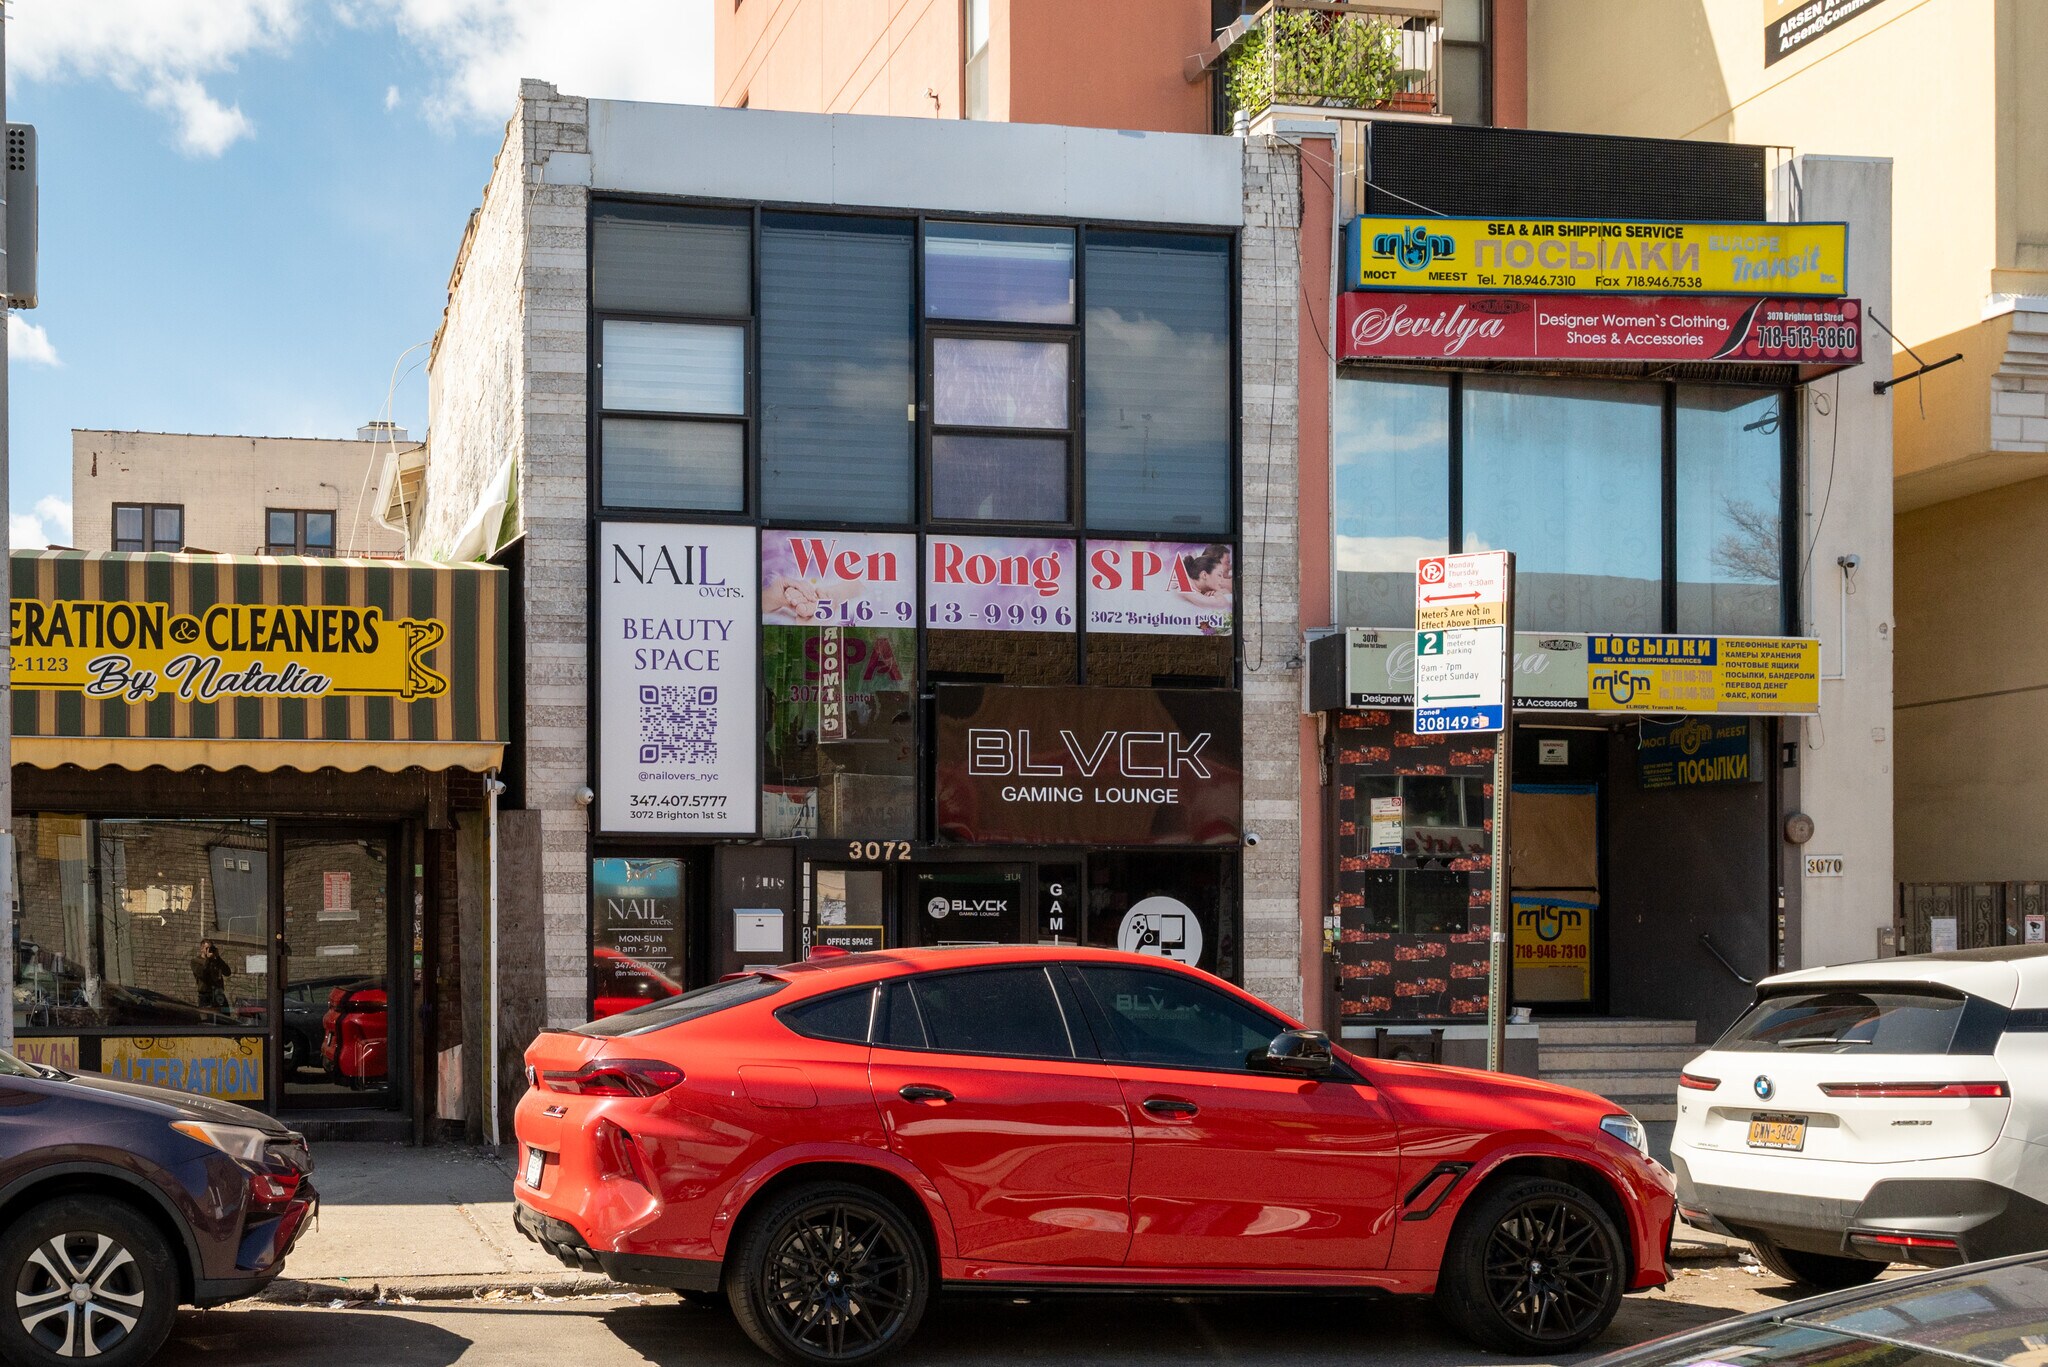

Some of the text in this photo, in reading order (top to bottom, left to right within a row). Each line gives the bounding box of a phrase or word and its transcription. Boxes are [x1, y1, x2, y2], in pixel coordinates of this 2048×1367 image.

[1779, 1, 1822, 38] ARSEN
[1488, 224, 1684, 238] SEA & AIR SHIPPING SERVICE
[1708, 236, 1780, 252] EUROPE
[1474, 239, 1699, 272] ПОСЫЛКИ
[1732, 245, 1820, 283] Transit
[1429, 272, 1468, 281] MEEST
[1477, 274, 1702, 288] Tel. 718.946.7310 Fax 718.946.7538
[1540, 314, 1598, 328] Designer
[1670, 316, 1730, 331] Clothing,
[1767, 312, 1844, 322] 3070 Brighton 1st Street
[1352, 304, 1505, 356] Sevilya
[1567, 332, 1704, 346] Shoes & Accessories
[1757, 326, 1856, 350] 718-513-3860
[612, 544, 726, 585] NAIL
[788, 538, 1194, 596] Wen Rong SPA
[1449, 569, 1479, 577] Thursday
[699, 586, 744, 598] overs.
[1092, 611, 1122, 623] 3072
[1126, 612, 1191, 627] Brighton
[1422, 610, 1448, 618] Meters
[1482, 606, 1490, 614] in
[10, 602, 164, 650] ERATION
[206, 607, 379, 654] CLEANERS
[622, 618, 734, 641] BEAUTY
[1422, 622, 1444, 630] Effect
[1363, 634, 1377, 642] 3070
[1424, 633, 1437, 654] 2
[1595, 638, 1710, 656] ПОСЫЛКИ
[634, 648, 720, 672] SPACE
[805, 636, 903, 680] SPA
[1421, 664, 1437, 672] 9am
[88, 656, 156, 700] By
[165, 655, 330, 698] Natalia
[1421, 672, 1479, 682] Except Sunday
[1769, 672, 1814, 680] БАНДЕРОЛИ
[1764, 682, 1788, 690] ДЕНЕГ
[1362, 694, 1401, 704] Designer
[1526, 699, 1578, 707] Accessories
[1418, 716, 1469, 730] 308149
[1717, 725, 1746, 738] MEEST
[969, 728, 1211, 778] BLVCK
[1678, 754, 1748, 784] ПОСЫЛКИ
[638, 772, 719, 782] @nailovers_nyc
[630, 795, 727, 807] 347.407.5777
[1002, 786, 1179, 804] GAMING LOUNGE
[630, 810, 727, 821] 3072 Brighton 1st St
[849, 841, 911, 860] 3072
[1808, 859, 1842, 873] 3070
[608, 899, 664, 920] NAIL
[952, 900, 1008, 912] BLVCK
[827, 938, 873, 946] OFFICE SPACE
[1516, 944, 1586, 958] 718-946-7310
